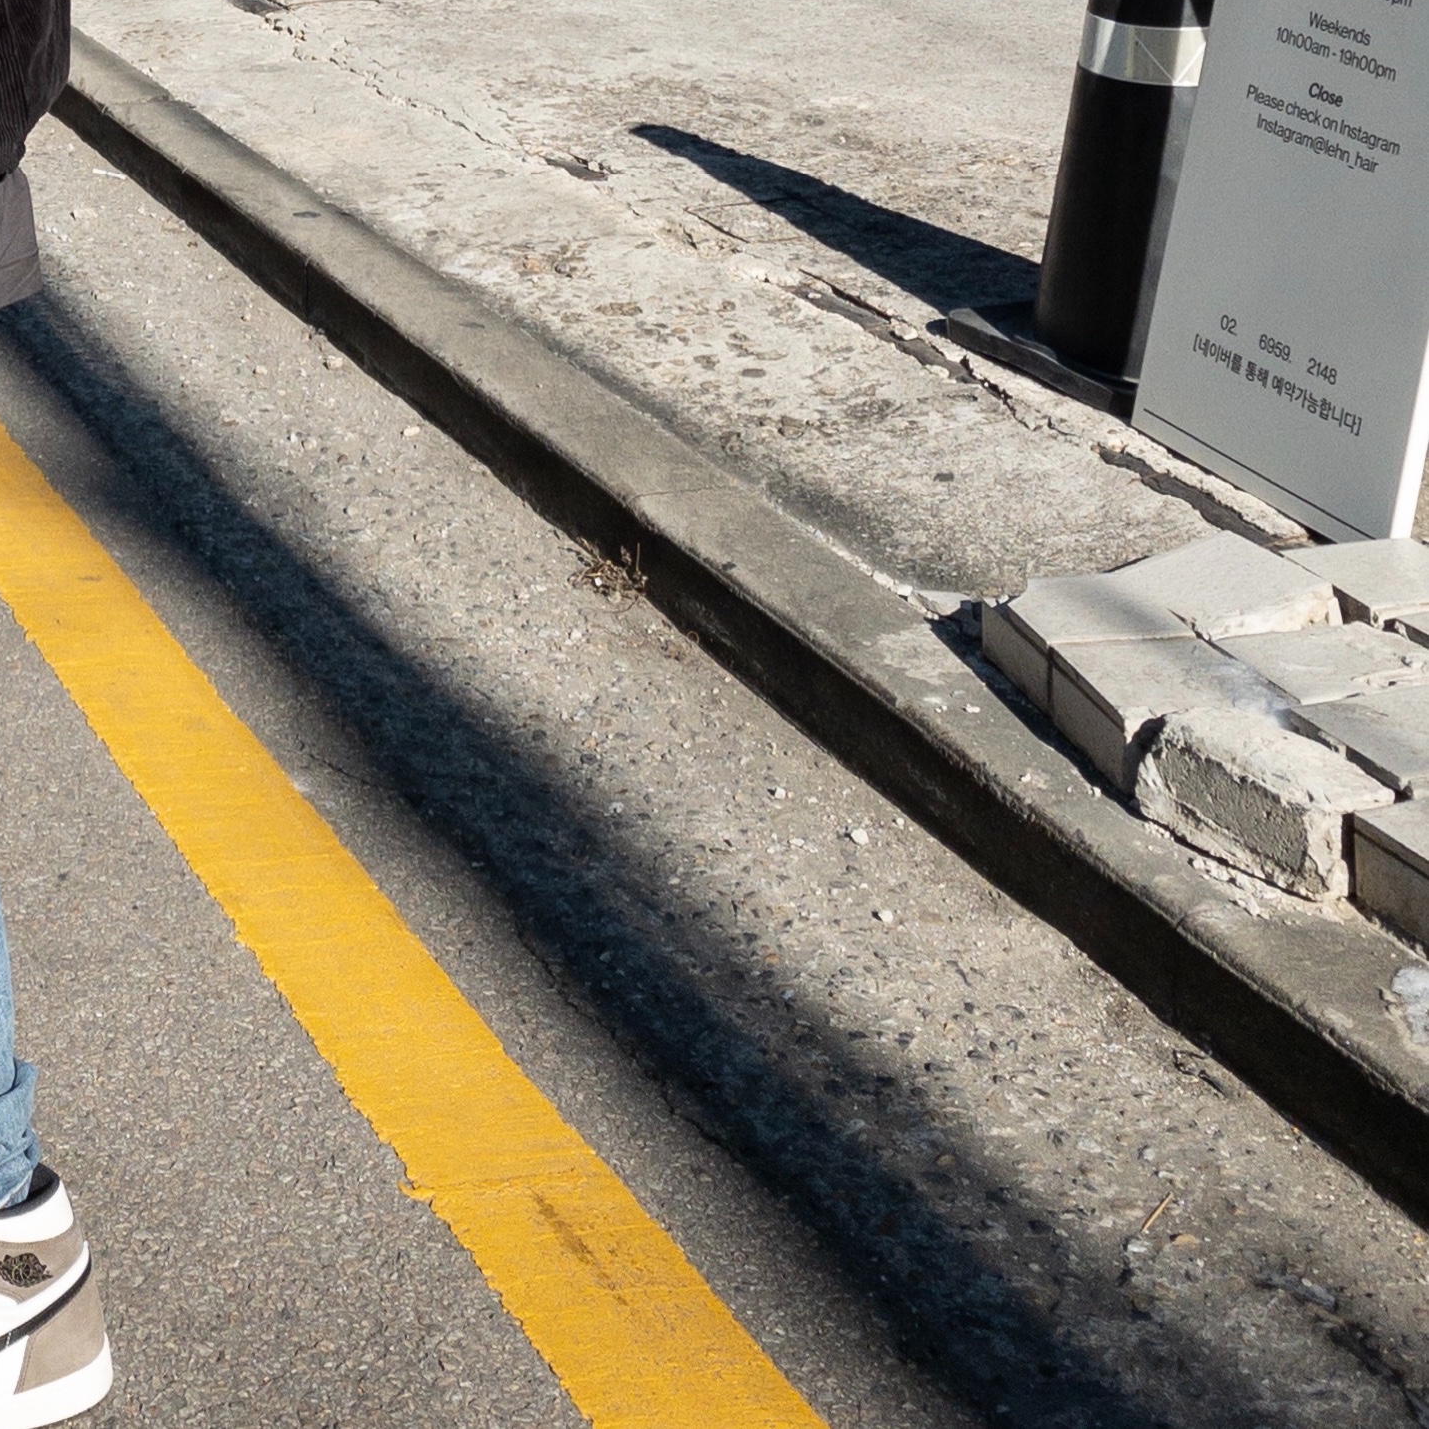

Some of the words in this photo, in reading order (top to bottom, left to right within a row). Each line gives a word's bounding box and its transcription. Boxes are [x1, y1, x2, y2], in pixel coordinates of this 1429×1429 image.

[1277, 26, 1330, 58] 10h00am
[1339, 48, 1397, 82] 19h00pm
[1309, 11, 1371, 46] Weekends
[1247, 84, 1284, 112] Please
[1285, 102, 1321, 126] check
[1322, 117, 1338, 132] on
[1339, 120, 1401, 155] Instagram
[1309, 82, 1343, 107] Close
[1257, 114, 1379, 173] Instagram@lehn_hair
[1193, 334, 1243, 374] [네이버를
[1245, 361, 1269, 388] 통해
[1271, 375, 1363, 436] 예약가능합니다]
[1259, 334, 1291, 364] 6959.
[1307, 358, 1337, 386] 2148
